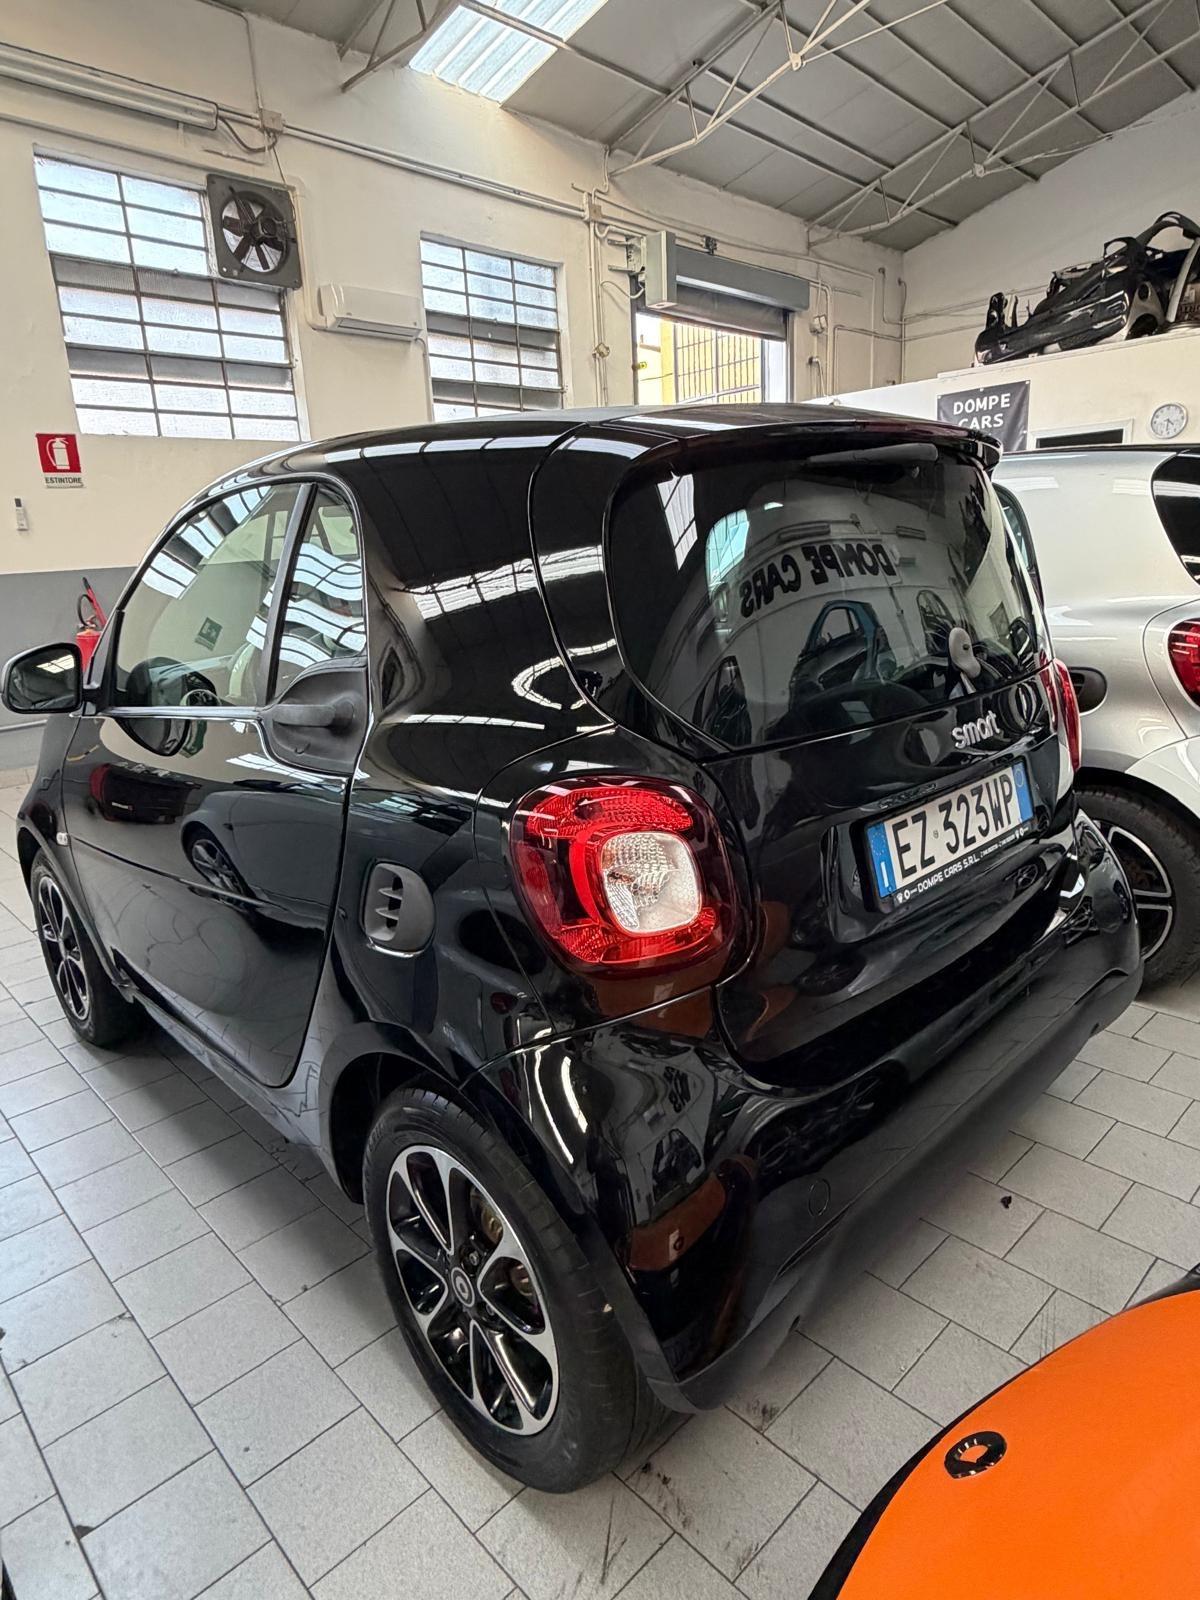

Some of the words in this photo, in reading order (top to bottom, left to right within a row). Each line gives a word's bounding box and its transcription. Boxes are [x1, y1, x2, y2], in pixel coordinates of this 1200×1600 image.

[953, 393, 1011, 415] DOMPE
[952, 710, 1000, 749] smart
[892, 811, 936, 879] EZ
[939, 774, 1013, 854] 323WP
[918, 872, 944, 893] DOMPE
[944, 861, 963, 879] CARS
